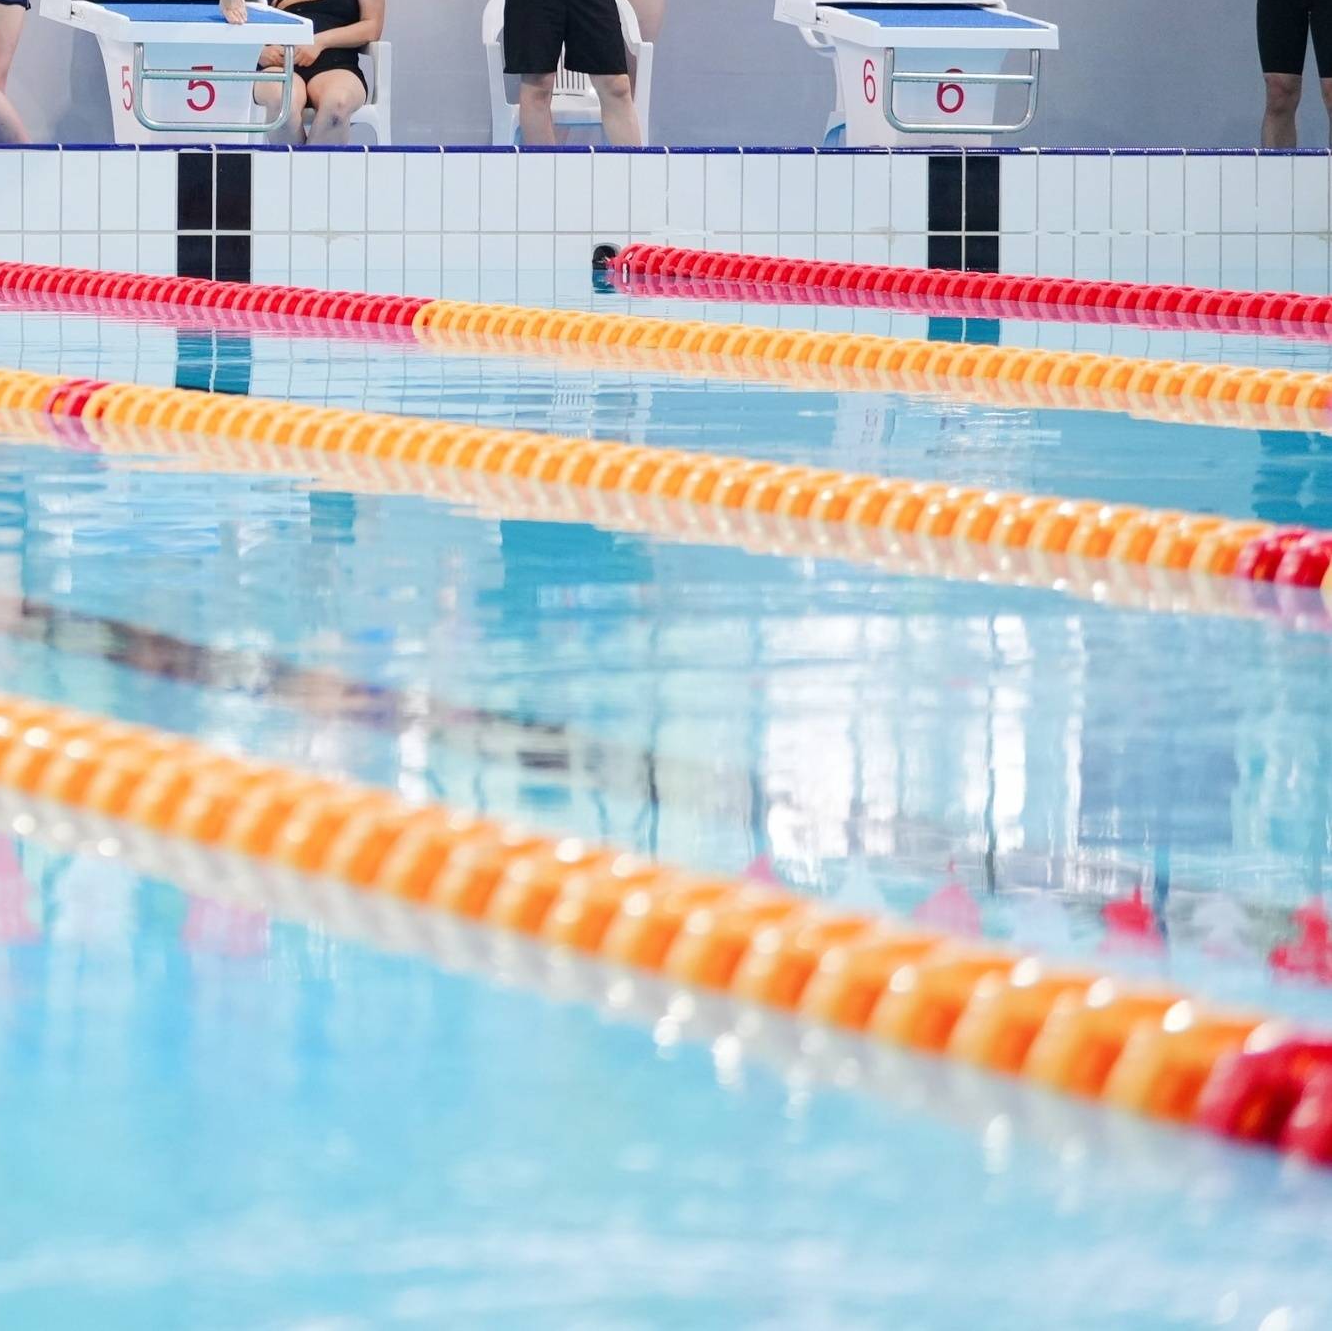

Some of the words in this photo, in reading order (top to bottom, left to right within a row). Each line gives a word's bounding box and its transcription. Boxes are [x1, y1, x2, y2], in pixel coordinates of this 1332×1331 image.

[186, 65, 216, 112] 5
[863, 59, 877, 104] 6
[936, 68, 965, 114] 6
